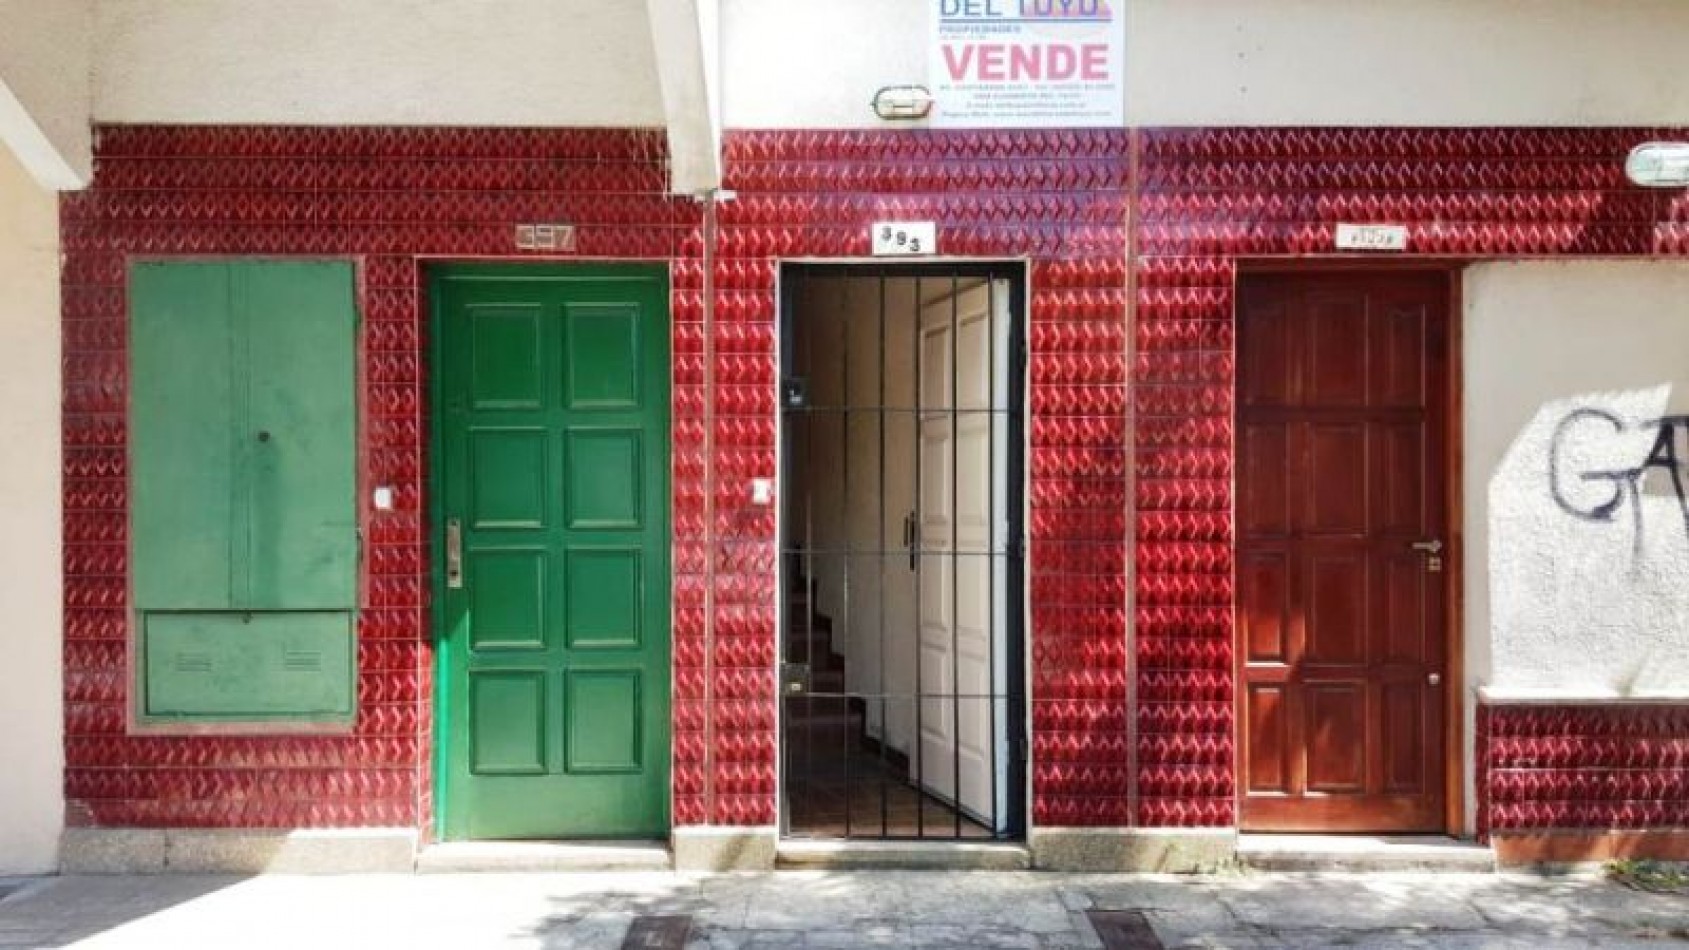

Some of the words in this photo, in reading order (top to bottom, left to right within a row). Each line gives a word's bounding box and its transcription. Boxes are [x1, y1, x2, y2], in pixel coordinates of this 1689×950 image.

[940, 0, 1003, 16] DEL
[941, 43, 1110, 81] VENDE
[880, 225, 921, 252] 393
